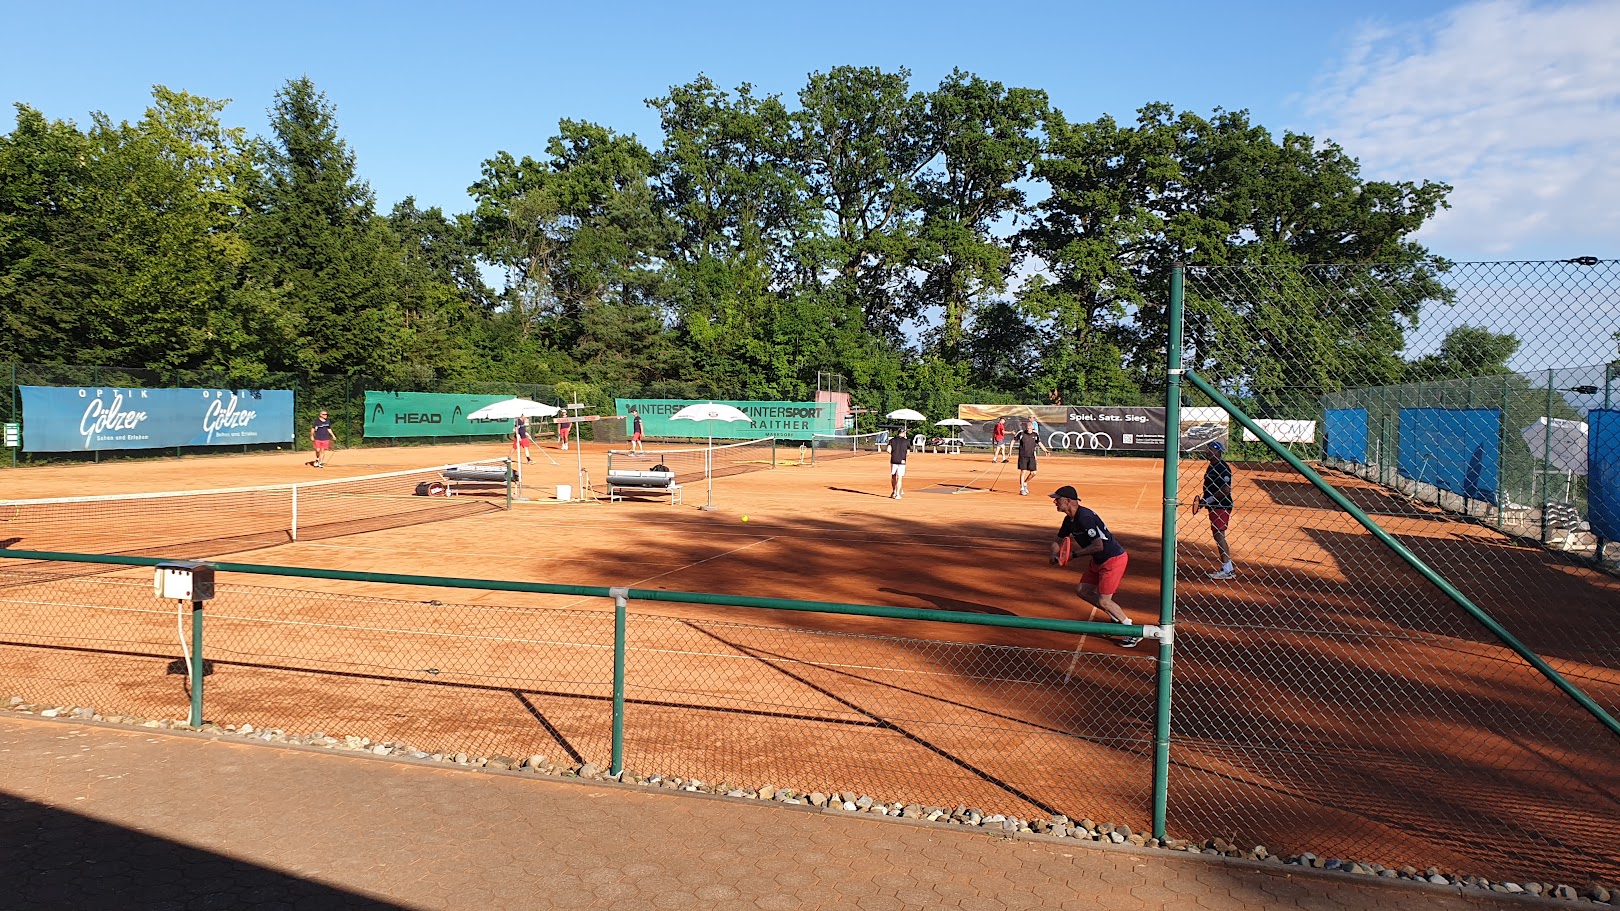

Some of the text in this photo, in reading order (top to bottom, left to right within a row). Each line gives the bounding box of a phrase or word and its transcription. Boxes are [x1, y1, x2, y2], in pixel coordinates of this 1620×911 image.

[78, 389, 148, 398] OPTIK
[750, 406, 823, 419] INTERSPORT
[80, 394, 148, 448] Gölzer
[203, 395, 257, 443] Gölzer
[395, 413, 442, 424] HEAD
[1069, 413, 1149, 424] Spiel. Satz. Sieg.
[750, 420, 809, 430] RAITHER
